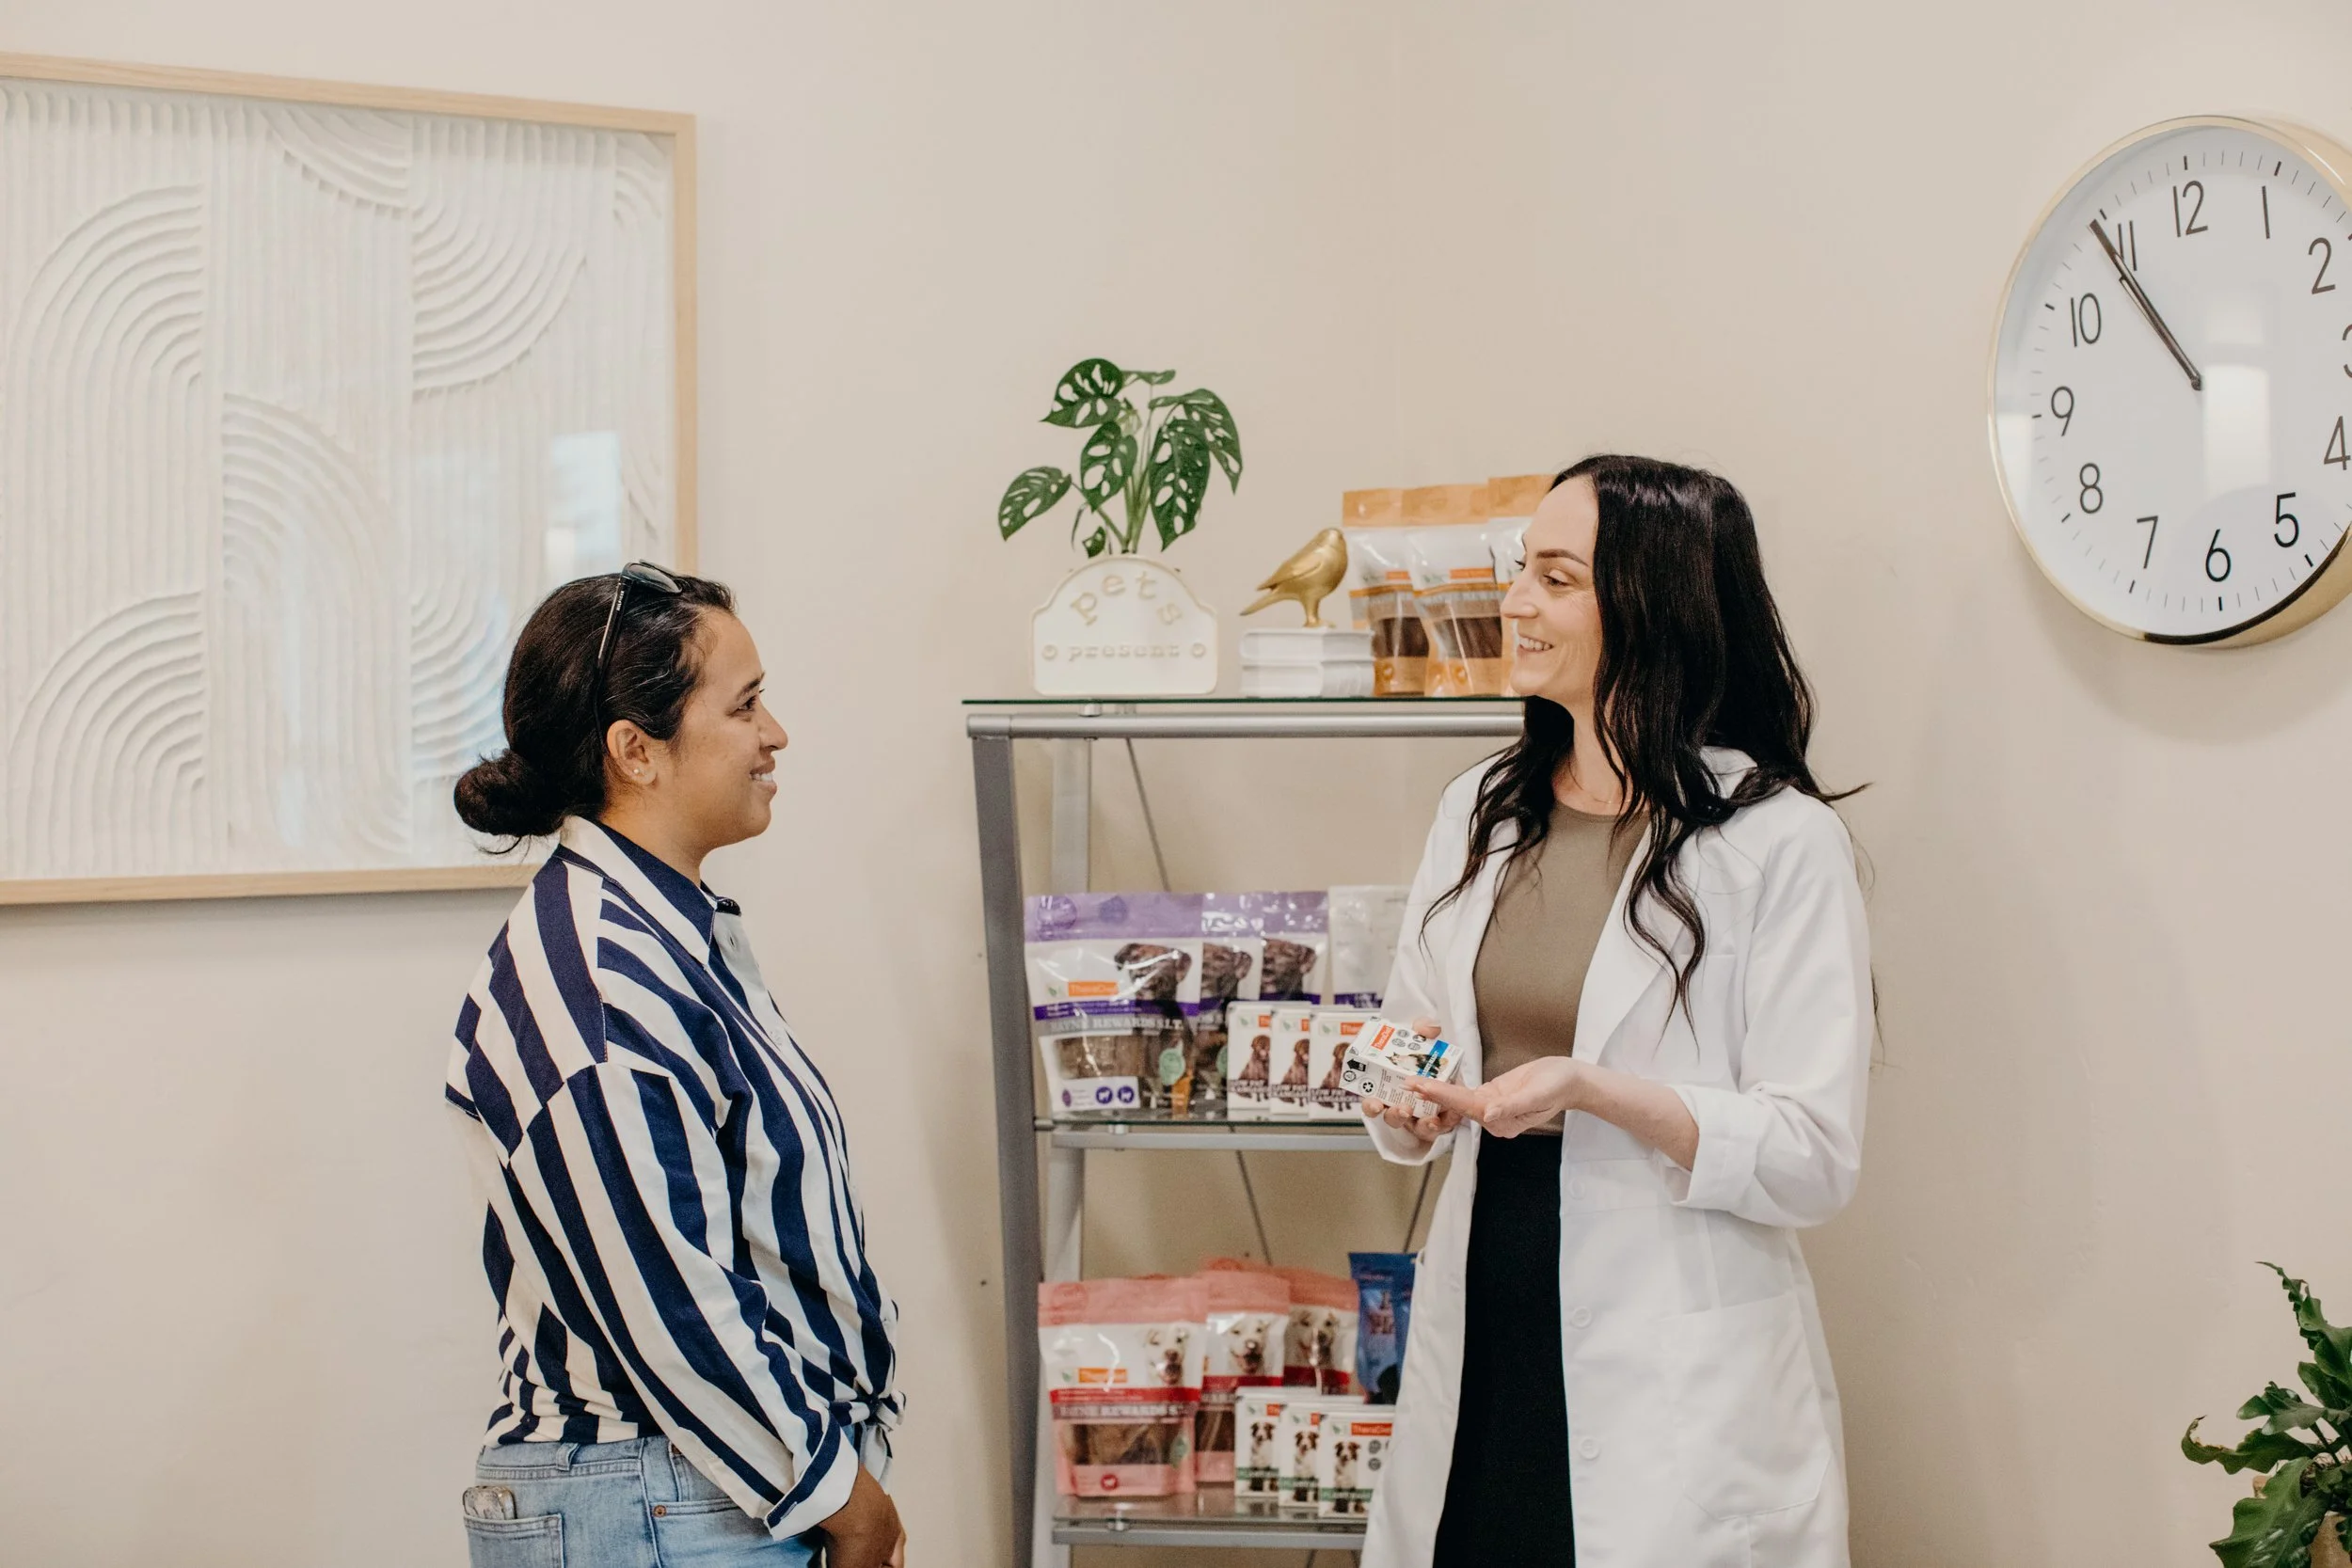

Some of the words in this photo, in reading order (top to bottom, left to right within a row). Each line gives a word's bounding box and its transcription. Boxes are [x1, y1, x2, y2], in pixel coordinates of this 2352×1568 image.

[2171, 180, 2209, 238] 12
[2261, 185, 2271, 240] 1
[2117, 219, 2137, 272] 11
[2307, 236, 2336, 294] 2
[2069, 292, 2102, 347] 10
[2050, 385, 2075, 437] 9
[2323, 415, 2352, 470] 4
[2079, 462, 2104, 515] 8
[2136, 515, 2159, 570] 7
[2273, 491, 2300, 547] 5
[2204, 528, 2232, 583] 6
